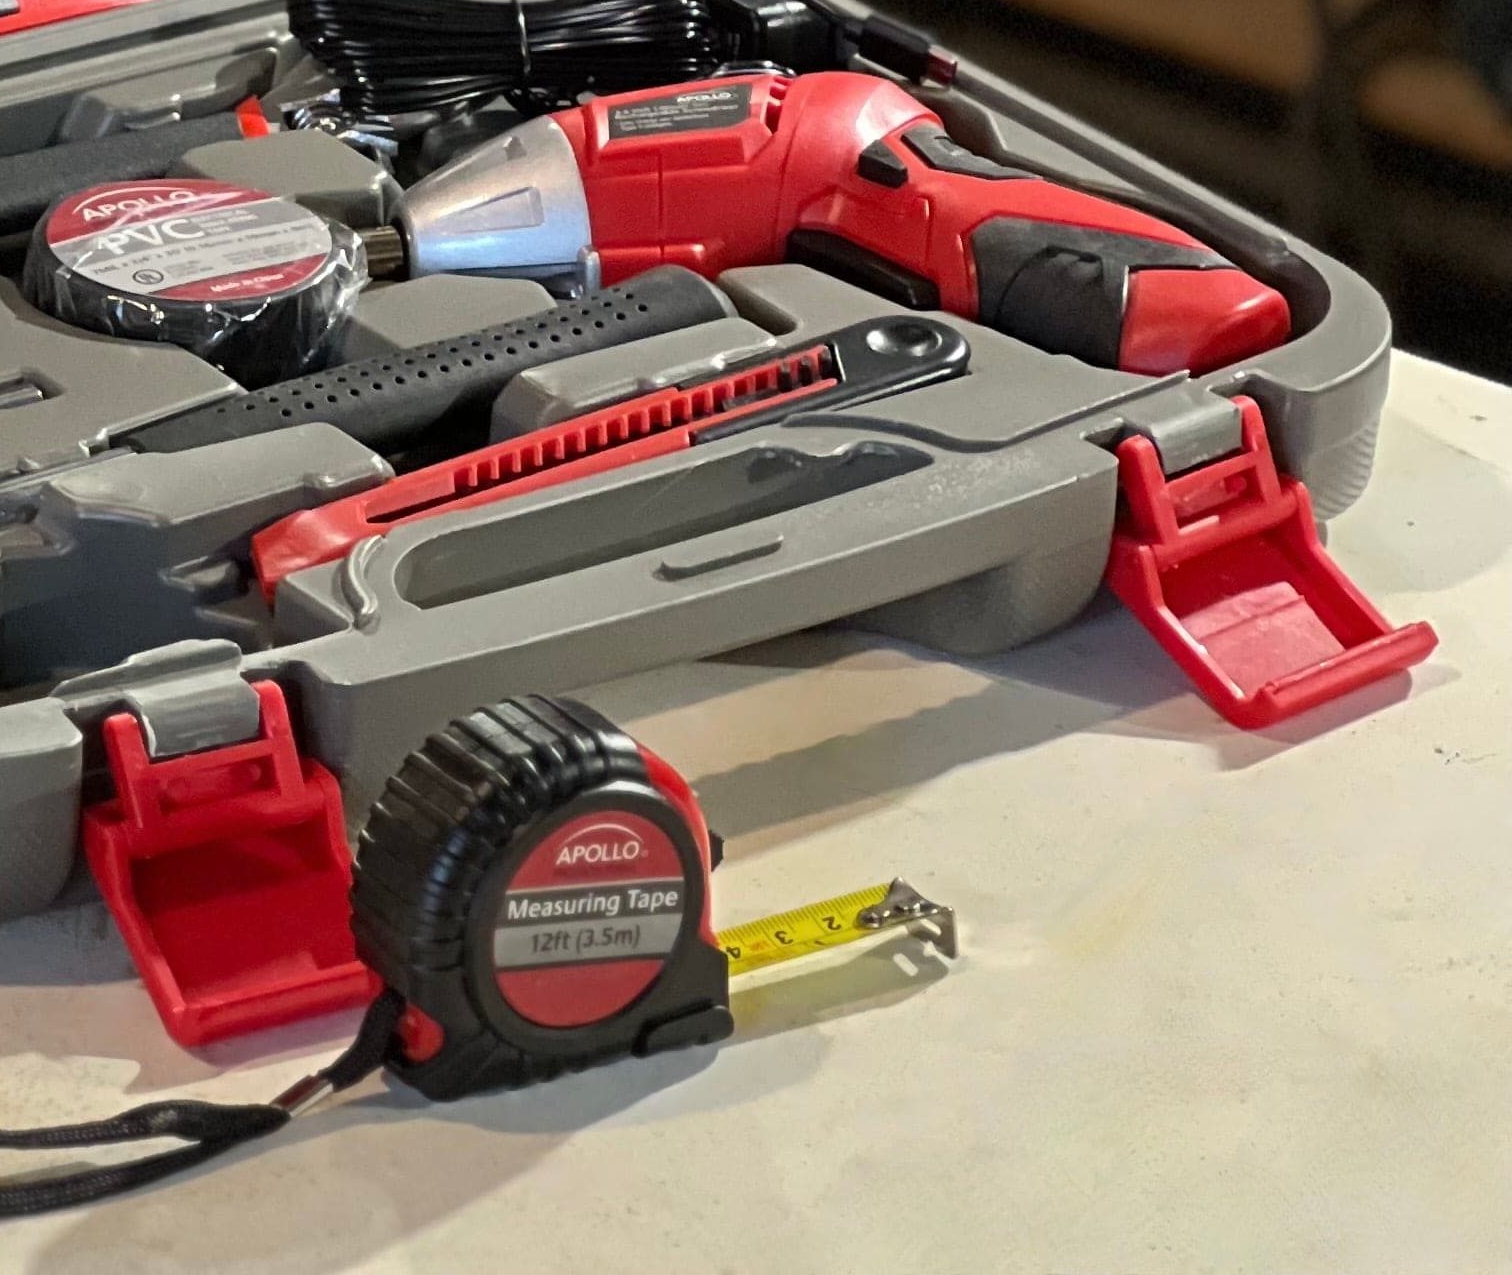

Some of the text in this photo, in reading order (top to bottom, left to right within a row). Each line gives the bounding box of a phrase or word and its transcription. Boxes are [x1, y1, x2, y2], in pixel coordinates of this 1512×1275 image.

[81, 190, 194, 222] APOLLO
[101, 218, 205, 255] PVC
[555, 841, 641, 866] APOLLO
[507, 888, 679, 921] Measuring Tape
[821, 915, 842, 931] 2
[530, 925, 641, 953] 12ft (3.5m)
[774, 930, 794, 945] 3
